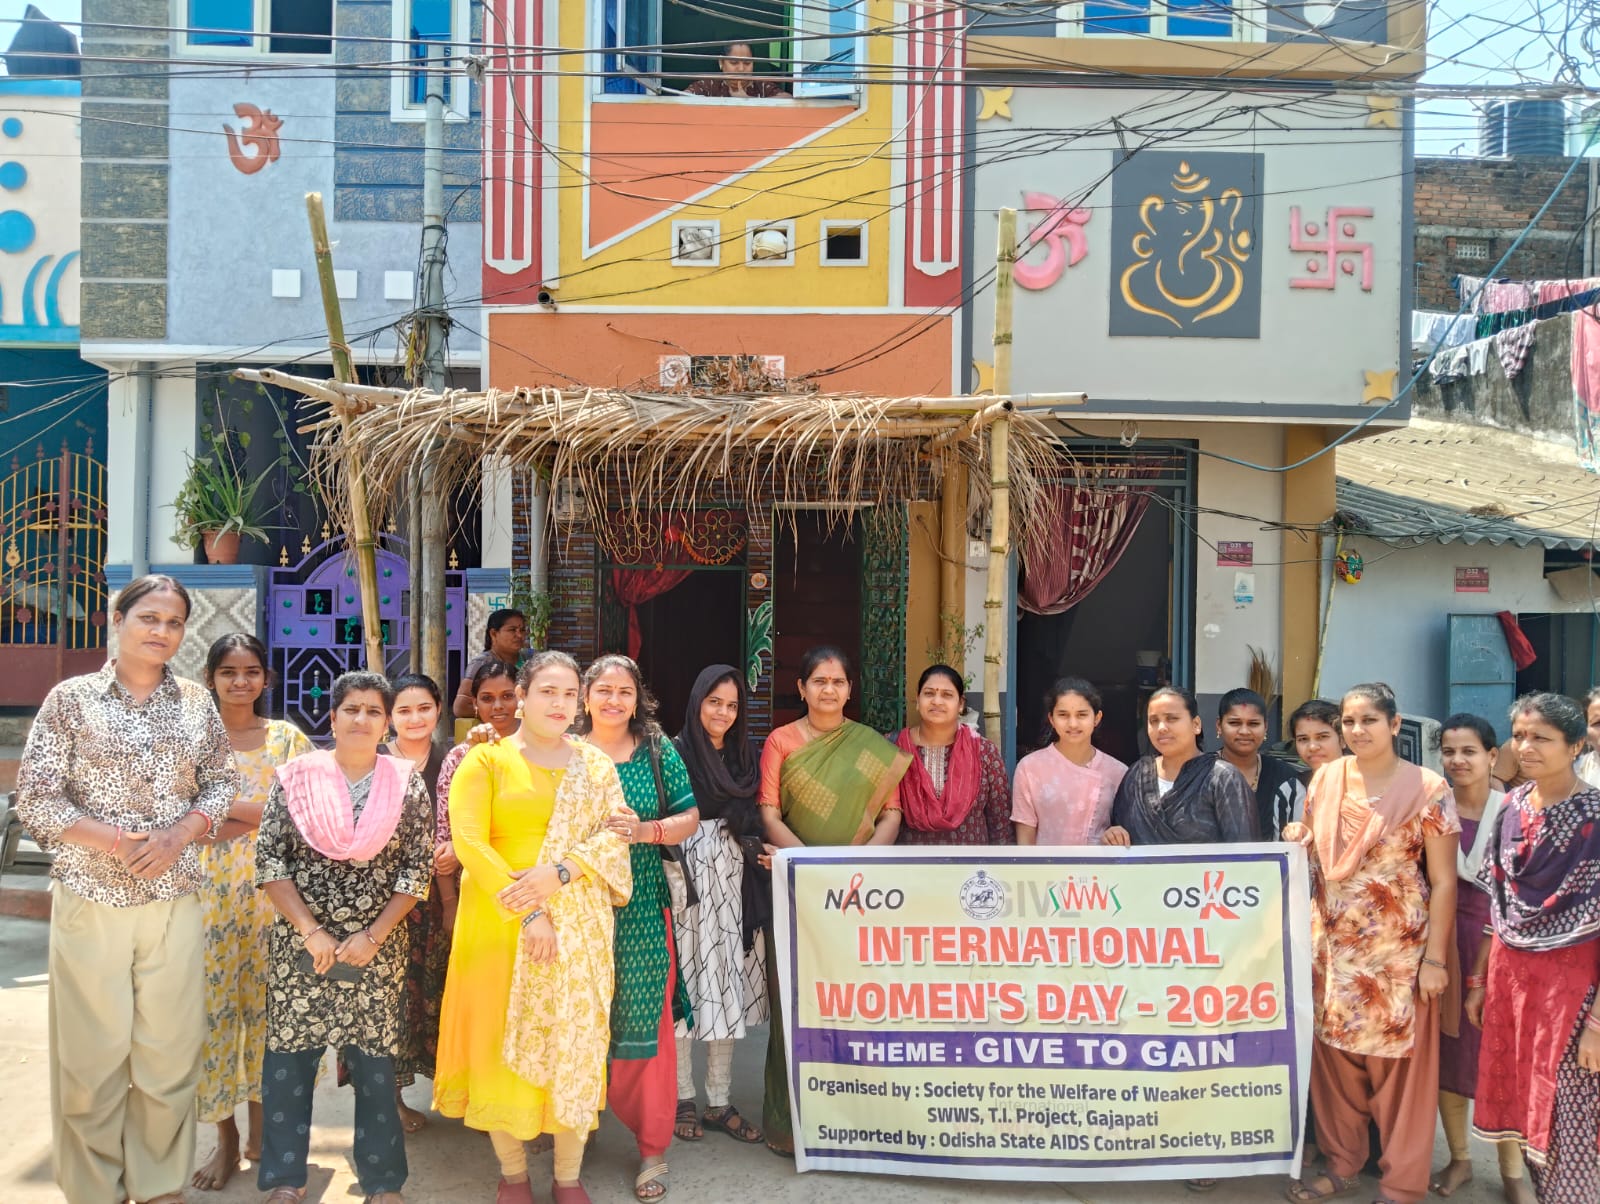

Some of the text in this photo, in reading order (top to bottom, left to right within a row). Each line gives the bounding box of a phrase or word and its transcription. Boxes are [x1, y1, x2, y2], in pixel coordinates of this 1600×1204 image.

[824, 884, 904, 913] NACO
[858, 926, 1220, 964] INTERNATIONAL
[815, 981, 1026, 1021] WOMEN'S
[1037, 984, 1124, 1021] DAY
[1166, 981, 1277, 1023] 2026
[848, 1041, 946, 1062] THEME
[974, 1037, 1063, 1064] GIVE
[1076, 1039, 1127, 1065] TO
[1141, 1039, 1235, 1067] GAIN
[807, 1076, 888, 1097] Organised
[892, 1082, 911, 1101] by
[923, 1082, 984, 1101] Society
[989, 1081, 1014, 1099] for
[1017, 1083, 1045, 1099] the
[1050, 1084, 1117, 1101] Welfare
[1121, 1085, 1139, 1101] of
[1143, 1084, 1207, 1102] Weaker
[1210, 1081, 1282, 1098] Sections
[927, 1107, 985, 1125] SWWS,
[988, 1107, 1013, 1124] T.I.
[1016, 1108, 1082, 1128] Project,
[1086, 1110, 1159, 1130] Gajapati
[818, 1125, 903, 1145] Supported
[907, 1130, 926, 1150] by
[939, 1132, 996, 1148] Odisha
[1000, 1133, 1046, 1150] State
[1050, 1135, 1090, 1151] AIDS
[1160, 1131, 1226, 1150] Society,
[1231, 1129, 1275, 1146] BBSR
